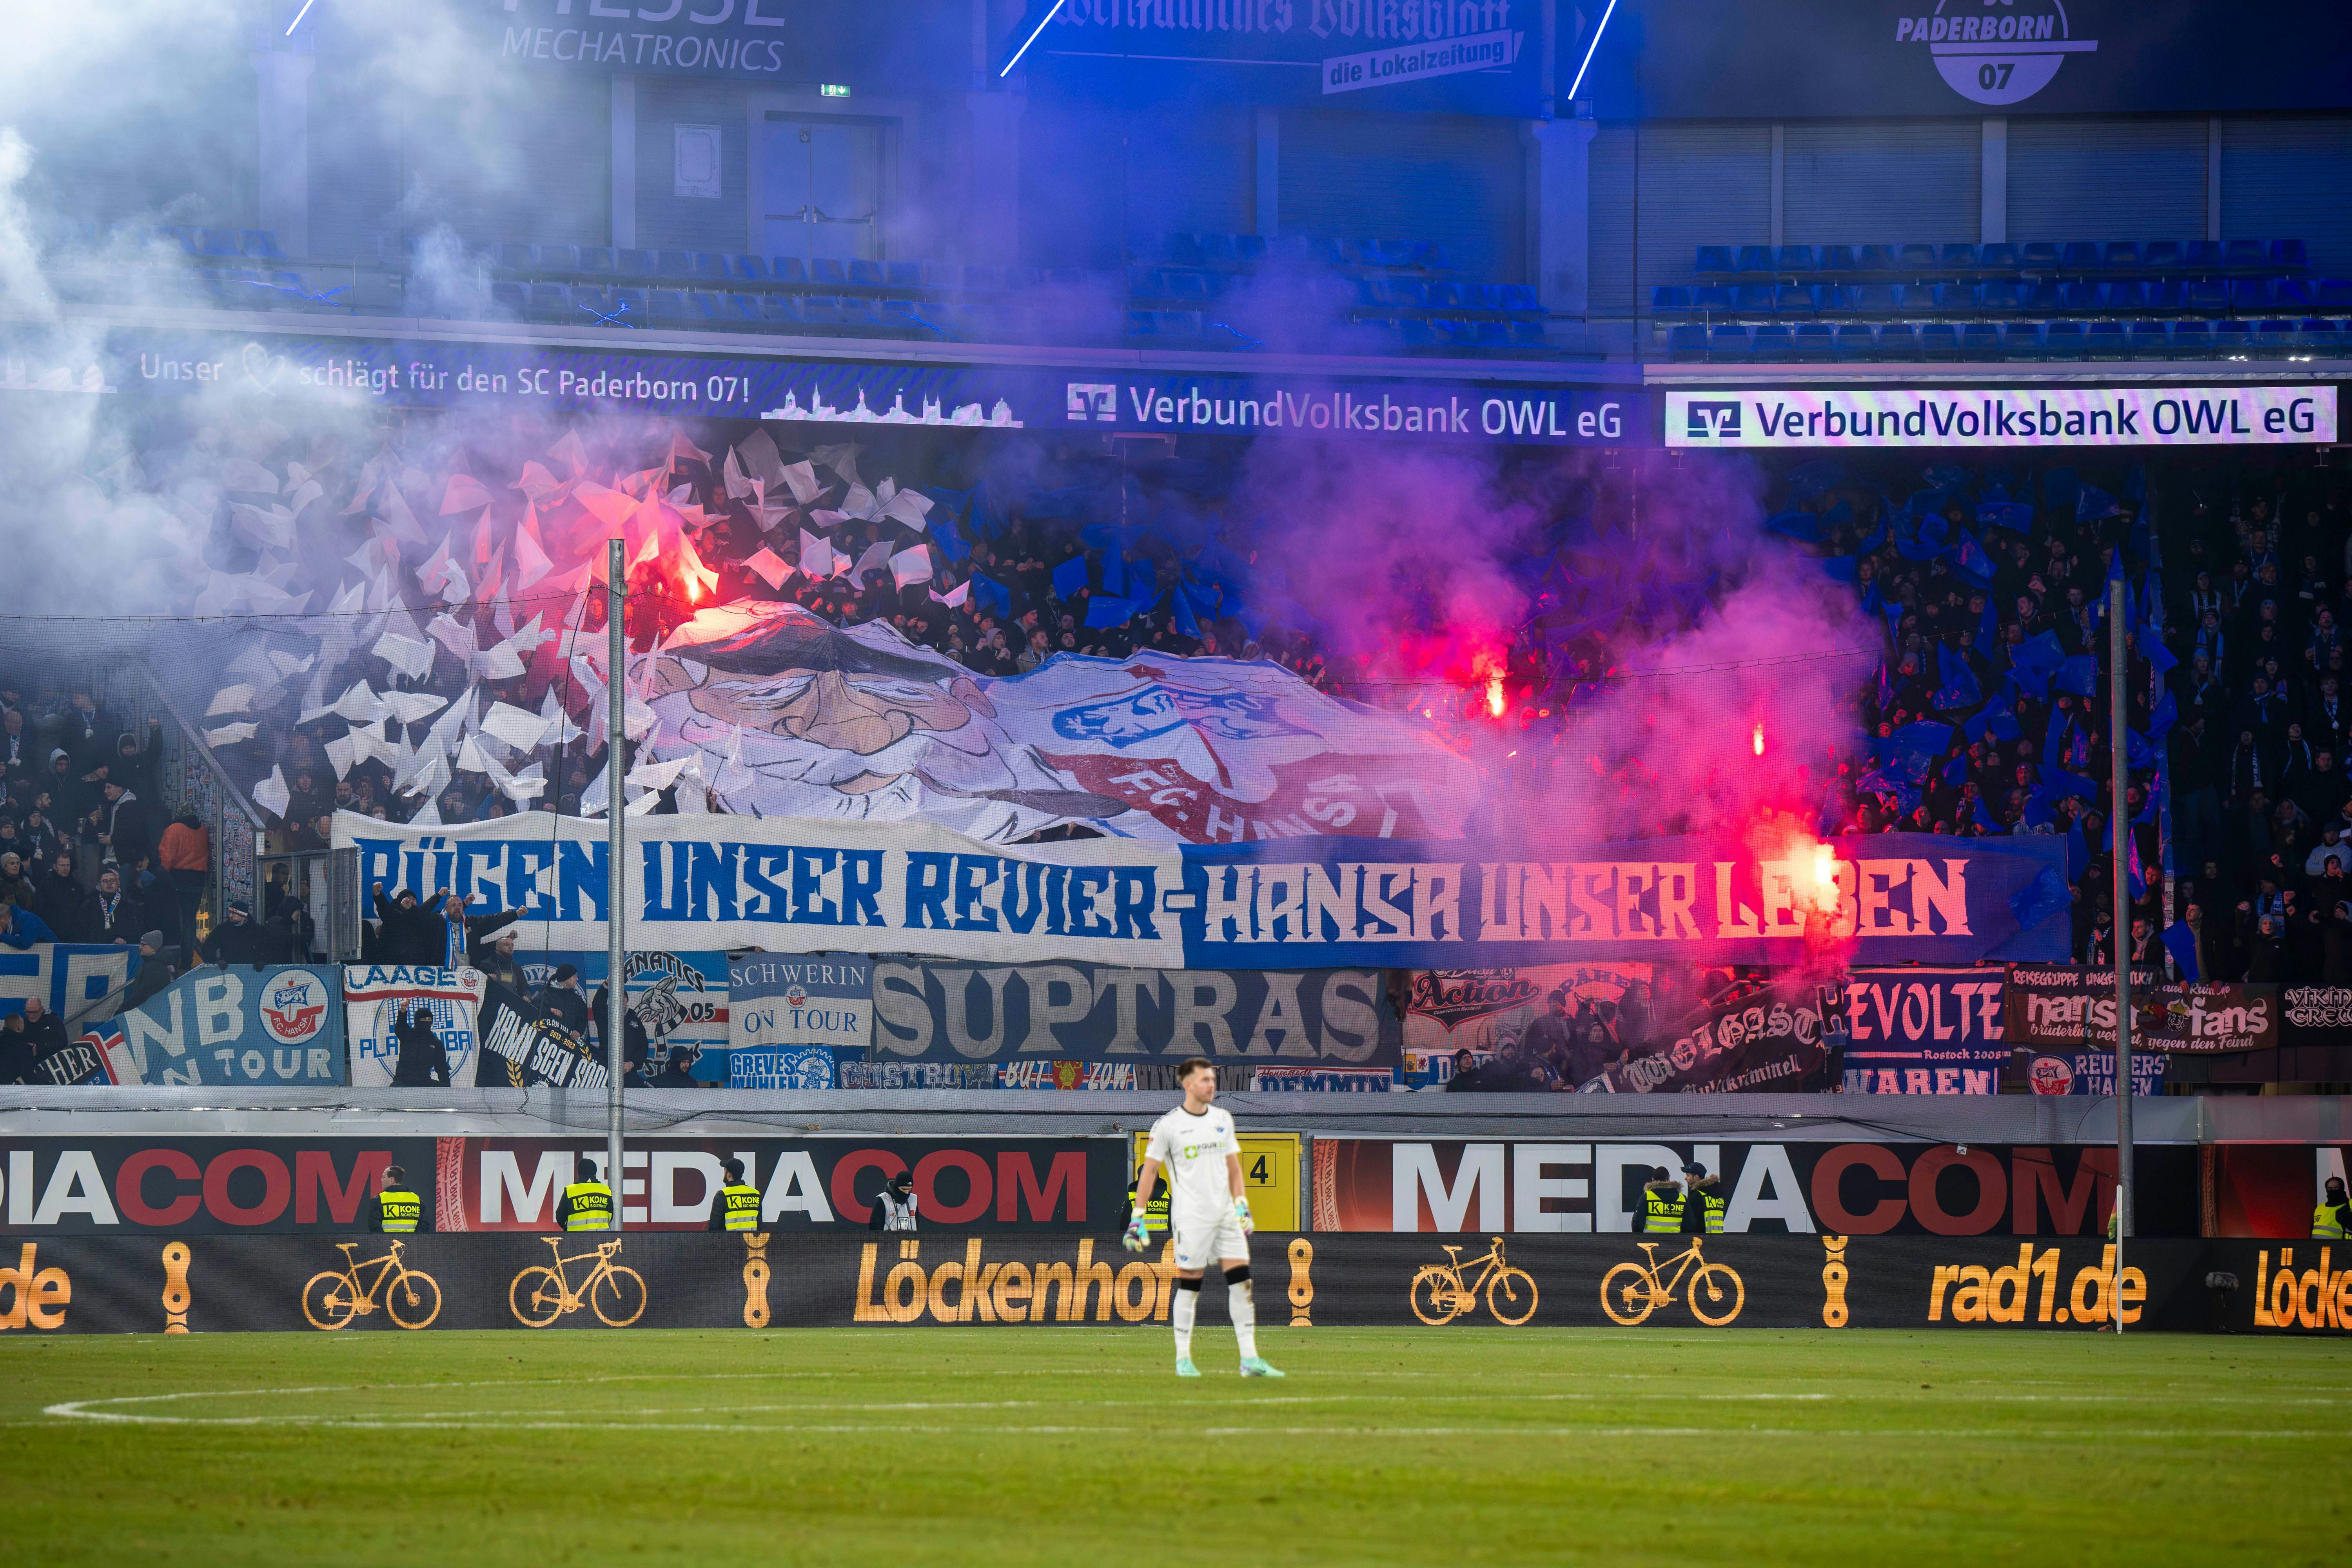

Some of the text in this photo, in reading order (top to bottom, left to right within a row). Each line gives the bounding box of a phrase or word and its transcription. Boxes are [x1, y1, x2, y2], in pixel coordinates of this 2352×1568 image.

[1896, 15, 2054, 41] PADERBORN
[502, 26, 784, 71] MECHATRONICS
[1330, 40, 1504, 85] die Lokalzeitung
[1978, 63, 2015, 90] 07
[141, 353, 749, 403] Unser schlägt für den SC Paderborn 07!
[1129, 387, 1621, 438] VerbundVolksbank OWL eG
[1755, 397, 2315, 438] VerbundVolksbank OWL eG
[351, 837, 609, 922] RÜGEN
[640, 840, 887, 927] UNSER
[1480, 862, 1704, 941] UNSER
[624, 951, 705, 993] ANATICS
[730, 963, 866, 987] SCHWERIN
[2013, 969, 2079, 987] REISEGRUPPE
[1413, 978, 1540, 1009] Action
[2285, 985, 2352, 1008] VIKIN
[690, 1002, 716, 1022] 05
[744, 1009, 858, 1033] ON TOUR
[873, 963, 1379, 1062] SUPTRAS
[1842, 982, 2005, 1042] EVOLTE
[2189, 996, 2269, 1036] fans
[283, 1017, 309, 1035] HANSA
[550, 1029, 562, 1040] 2013
[563, 1038, 576, 1050] 2023
[1923, 1049, 2002, 1060] Rostock 2008
[2148, 1038, 2187, 1051] gegen
[2190, 1037, 2216, 1050] den
[2218, 1034, 2254, 1049] Feind
[214, 1049, 332, 1079] TOUR
[730, 1053, 797, 1076] GREVES
[2075, 1054, 2165, 1075] REUERS
[1843, 1068, 1990, 1095] WAREN
[2087, 1076, 2152, 1096] HAEN
[1196, 1142, 1217, 1150] FOUR
[1250, 1155, 1270, 1185] 4
[0, 1149, 392, 1227] IACOM
[589, 1196, 608, 1205] KONE
[400, 1205, 420, 1214] KONE
[854, 1237, 1181, 1322] Löckenhof
[1927, 1242, 2148, 1325] rad1.de
